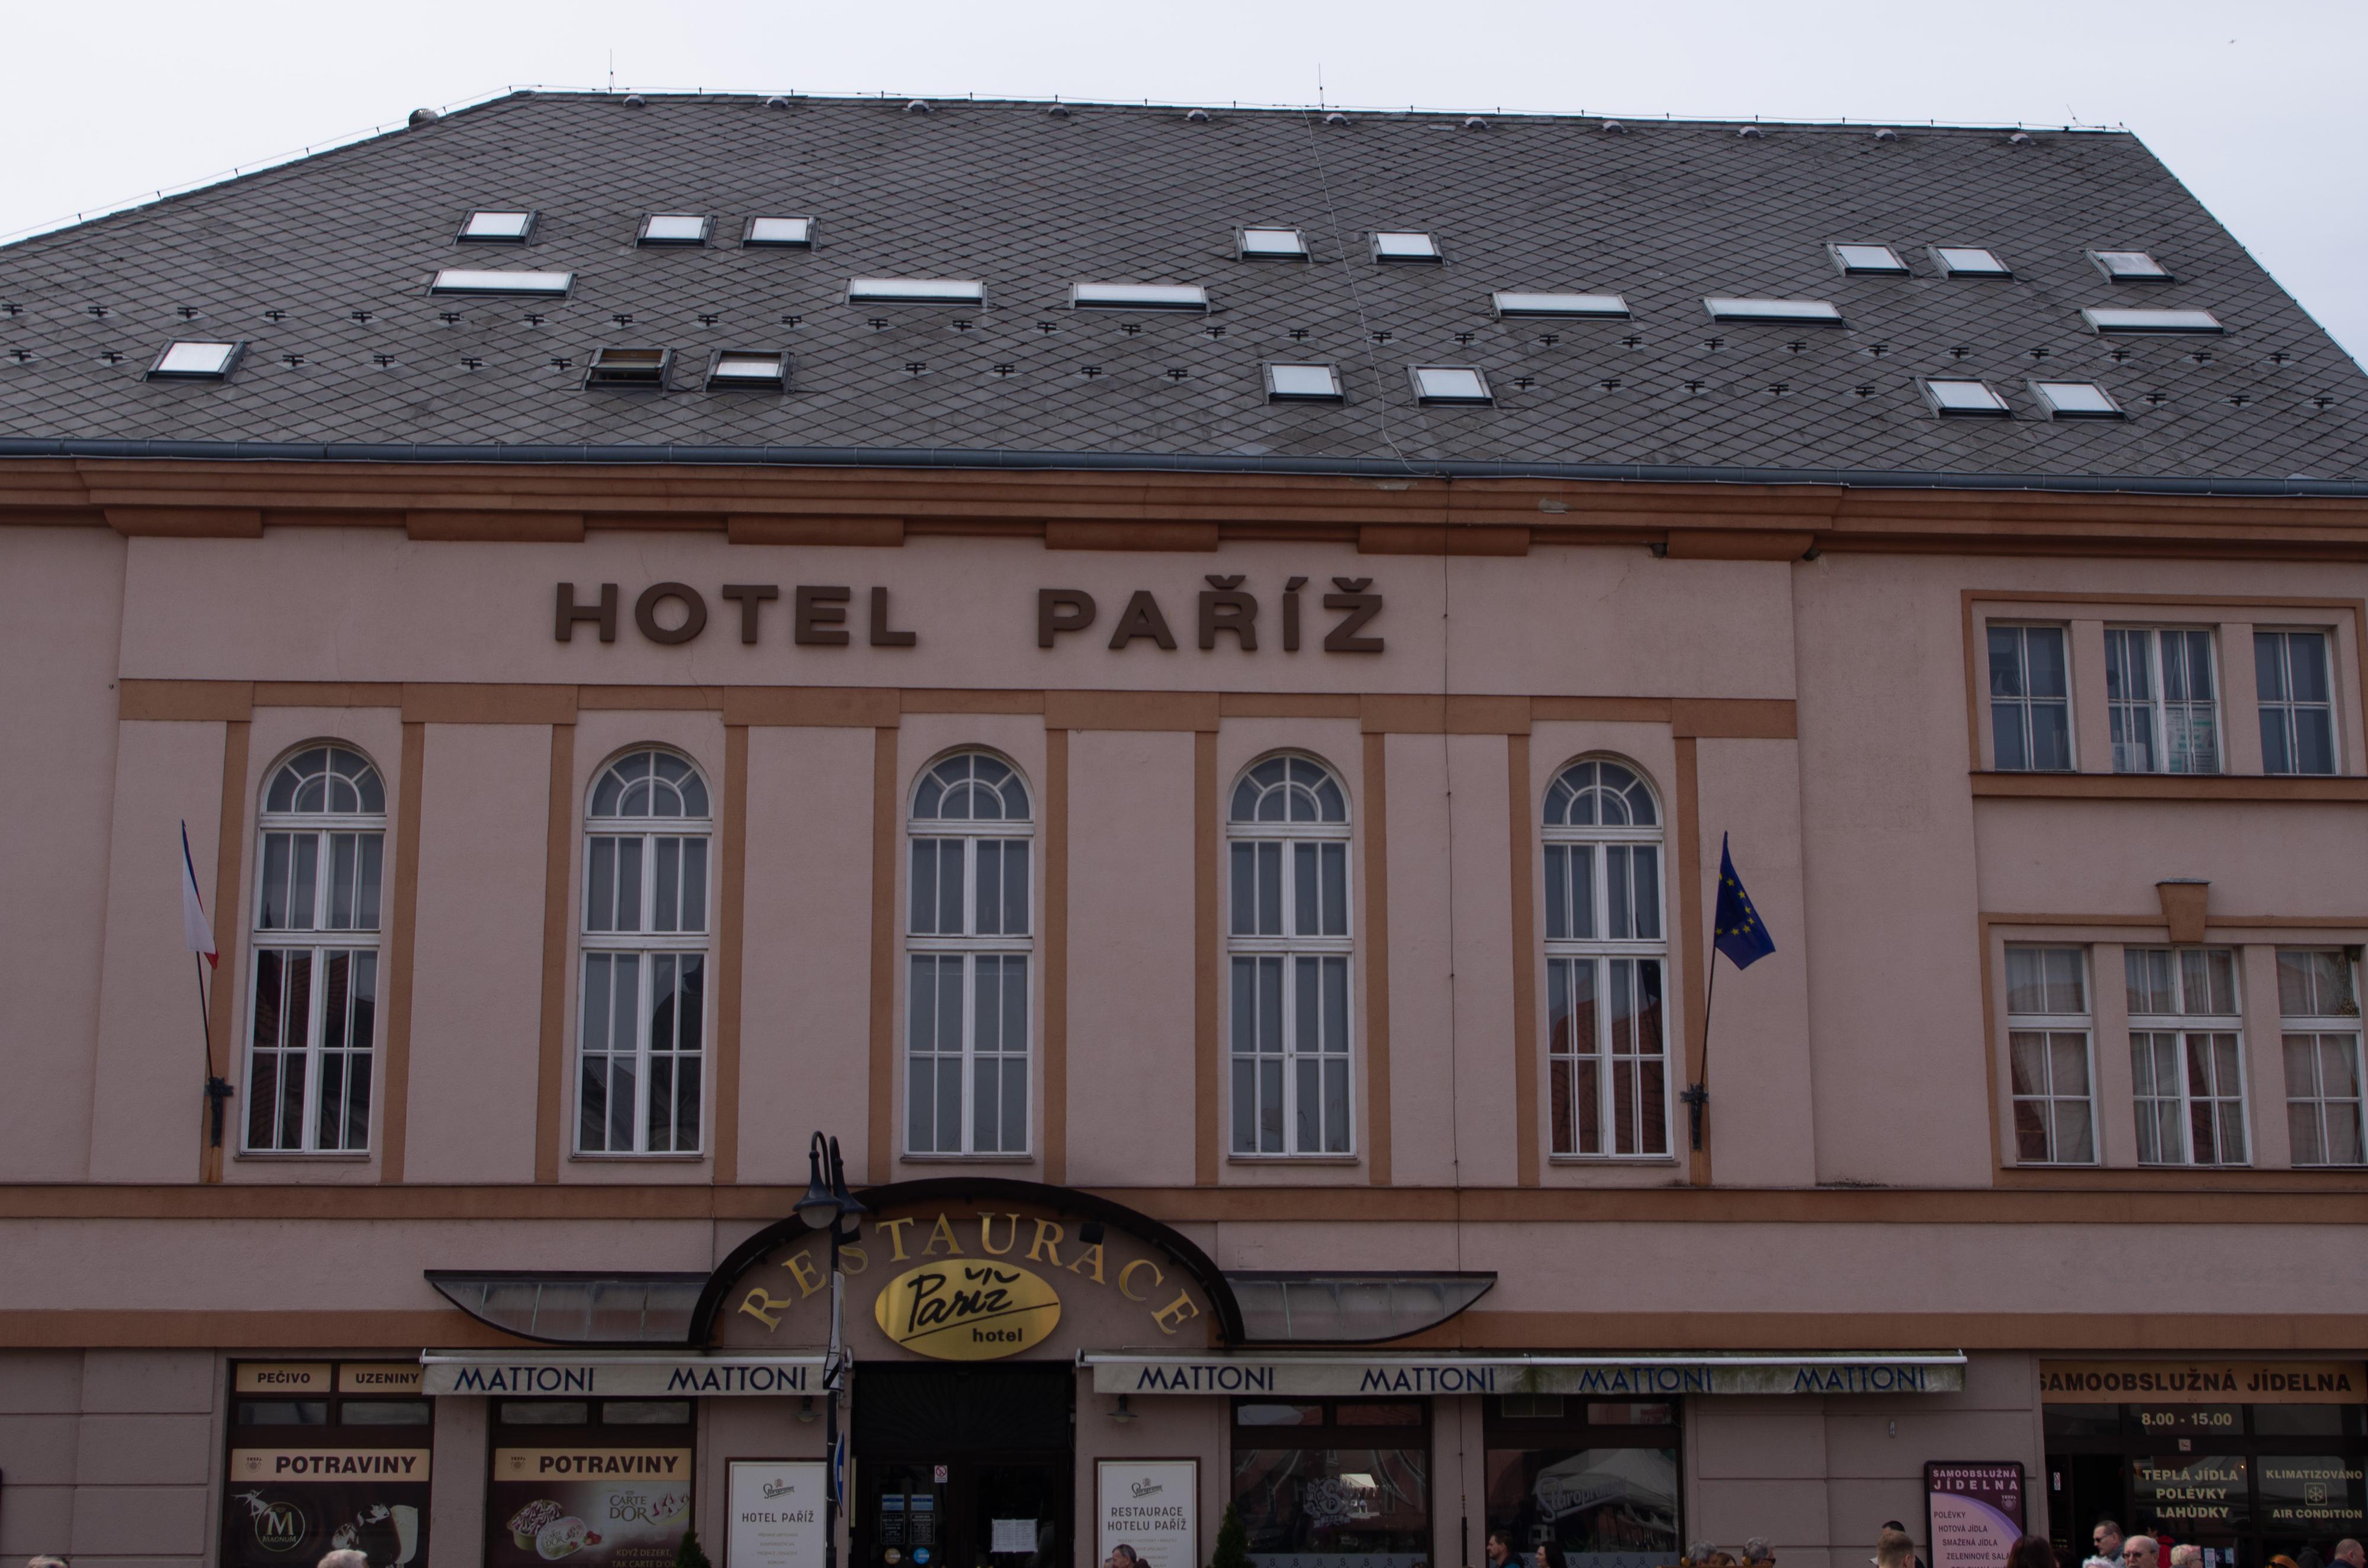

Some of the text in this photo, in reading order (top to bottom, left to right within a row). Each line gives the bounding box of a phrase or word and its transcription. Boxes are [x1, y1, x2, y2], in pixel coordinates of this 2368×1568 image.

[555, 575, 1384, 654] HOTEL PAŘÍŽ
[738, 1212, 1199, 1335] RESTAURACE
[973, 1328, 1022, 1342] hotel
[258, 1370, 311, 1383] PEČIVO
[356, 1372, 420, 1384] UZENINY
[453, 1367, 594, 1392] MATTONI
[668, 1367, 806, 1391] MATTONI
[1137, 1366, 1274, 1391] MATTONI
[1360, 1367, 1495, 1392] MATTONI
[1578, 1367, 1711, 1392] MATTONI
[1793, 1366, 1925, 1391] MATTONI
[2248, 1369, 2352, 1392] JÍDELNA
[2141, 1412, 2174, 1426] 8.00
[2191, 1412, 2232, 1426] 15.00
[276, 1456, 417, 1474] POTRAVINY
[539, 1456, 679, 1473] POTRAVINY
[1933, 1469, 2017, 1478] SAMOOBSLUŽNÁ
[2142, 1467, 2238, 1481] TEPLÁ JÍDLA
[2266, 1468, 2363, 1479] KLIMATIZOVÁNO
[763, 1483, 795, 1499] Staropra
[1131, 1482, 1163, 1499] Staropra
[1933, 1478, 2018, 1490] JÍDELNA
[2155, 1485, 2227, 1499] POLÉVKY
[610, 1495, 647, 1506] CARTE
[1536, 1477, 1629, 1523] Staropram
[742, 1511, 814, 1522] HOTEL PAŘÍŽ
[1111, 1506, 1183, 1517] RESTAURACE
[1933, 1510, 1966, 1518] POLÉVKY
[2156, 1504, 2229, 1518] LAHŮDKY
[2273, 1509, 2363, 1518] AIR CONDITION
[1108, 1518, 1186, 1531] HOTELU PAŘÍŽ
[1938, 1524, 1988, 1532] HOTOVÁ JÍDLA
[1942, 1538, 1998, 1547] SMAŽENÁ JÍDLA
[616, 1547, 673, 1558] KDYŽ DEZERT,
[1946, 1551, 1990, 1560] ZELENINOVÉ
